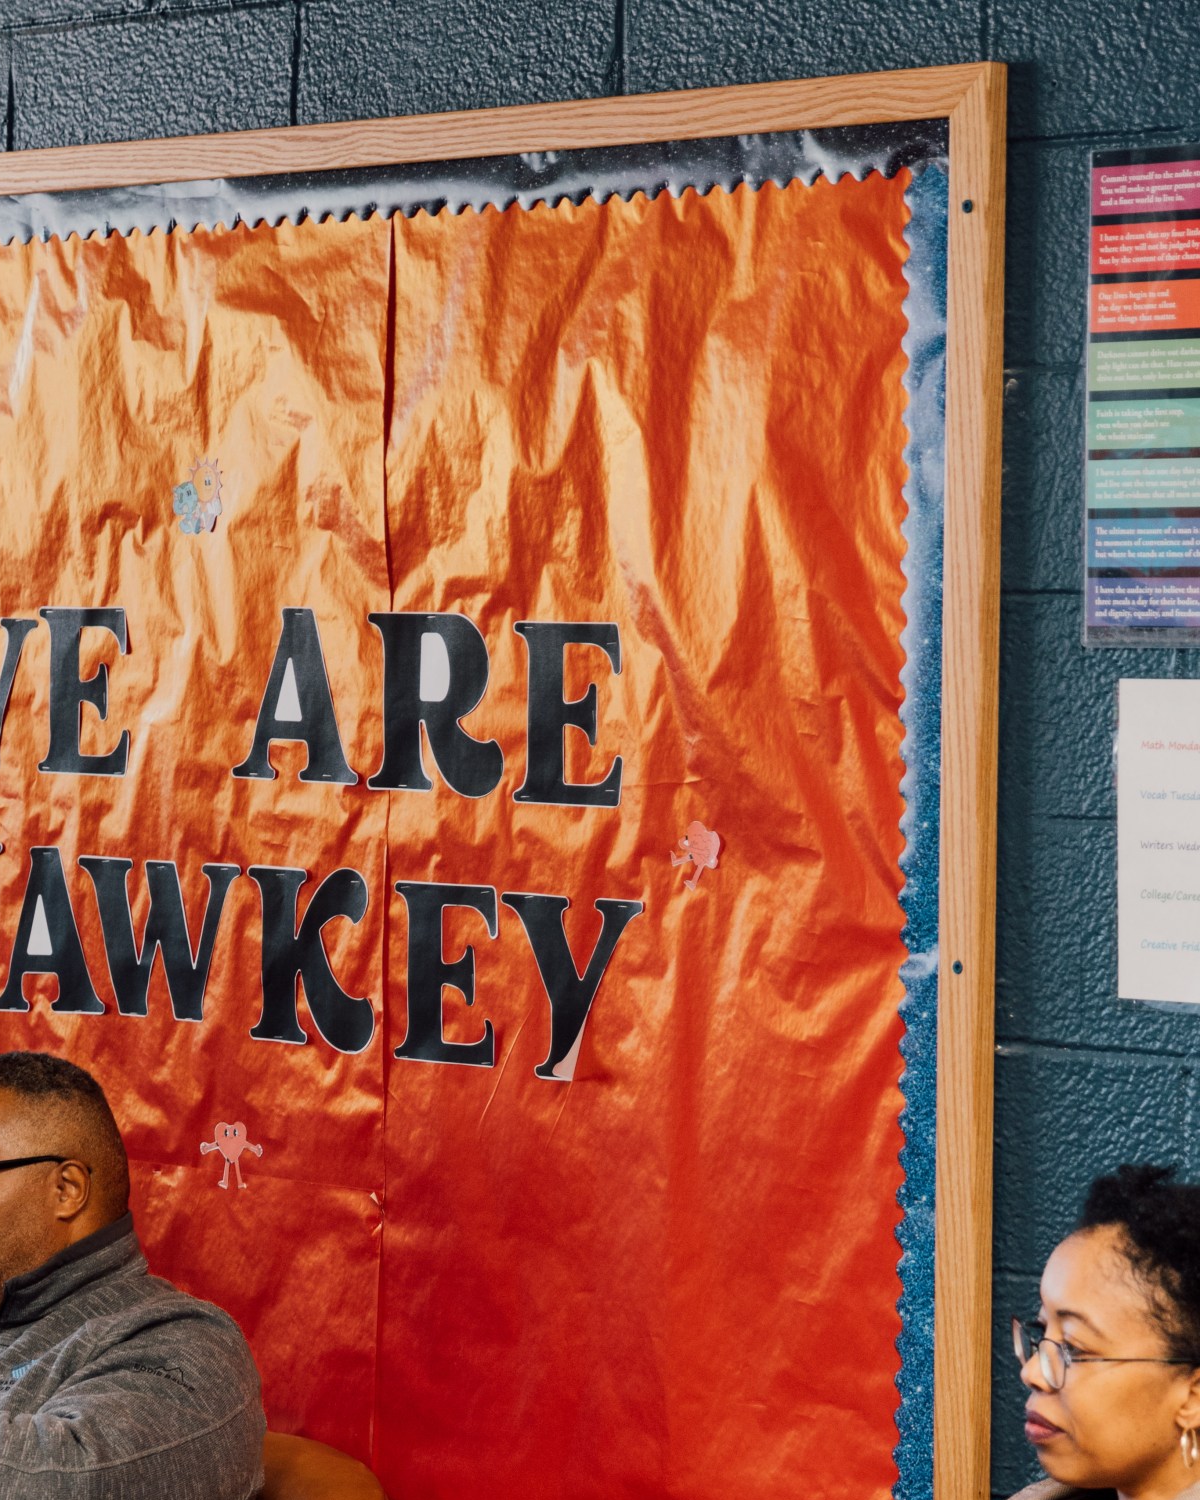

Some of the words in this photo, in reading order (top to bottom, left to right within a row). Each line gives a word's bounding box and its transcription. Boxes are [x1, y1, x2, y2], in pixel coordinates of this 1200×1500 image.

[1101, 175, 1127, 183] Commit
[1129, 172, 1154, 183] yourself
[1174, 183, 1195, 192] person
[1101, 198, 1112, 206] and
[1135, 195, 1153, 203] world
[1104, 233, 1118, 241] have
[1120, 244, 1133, 253] they
[1169, 240, 1190, 250] judged
[1121, 256, 1131, 264] the
[1129, 291, 1147, 301] begin
[1110, 304, 1121, 313] day
[1118, 315, 1137, 324] things
[1182, 537, 1194, 545] and
[1127, 586, 1153, 595] audacity
[1163, 585, 1185, 593] believe
[1187, 585, 1199, 593] that
[1095, 597, 1111, 605] three
[1112, 597, 1130, 605] meals
[1137, 597, 1148, 607] day
[1149, 597, 1159, 605] for
[1161, 597, 1176, 605] their
[1095, 609, 1107, 617] and
[1108, 609, 1132, 619] dignity,
[1134, 609, 1160, 619] equality,
[231, 606, 623, 808] ARE
[1141, 740, 1164, 749] Math
[1140, 790, 1167, 800] Vocab
[1171, 790, 1200, 800] Tuesda
[1140, 839, 1173, 850] Writers
[1140, 888, 1200, 903] College/Caree
[1140, 938, 1177, 951] Creative
[1181, 940, 1200, 952] Frid
